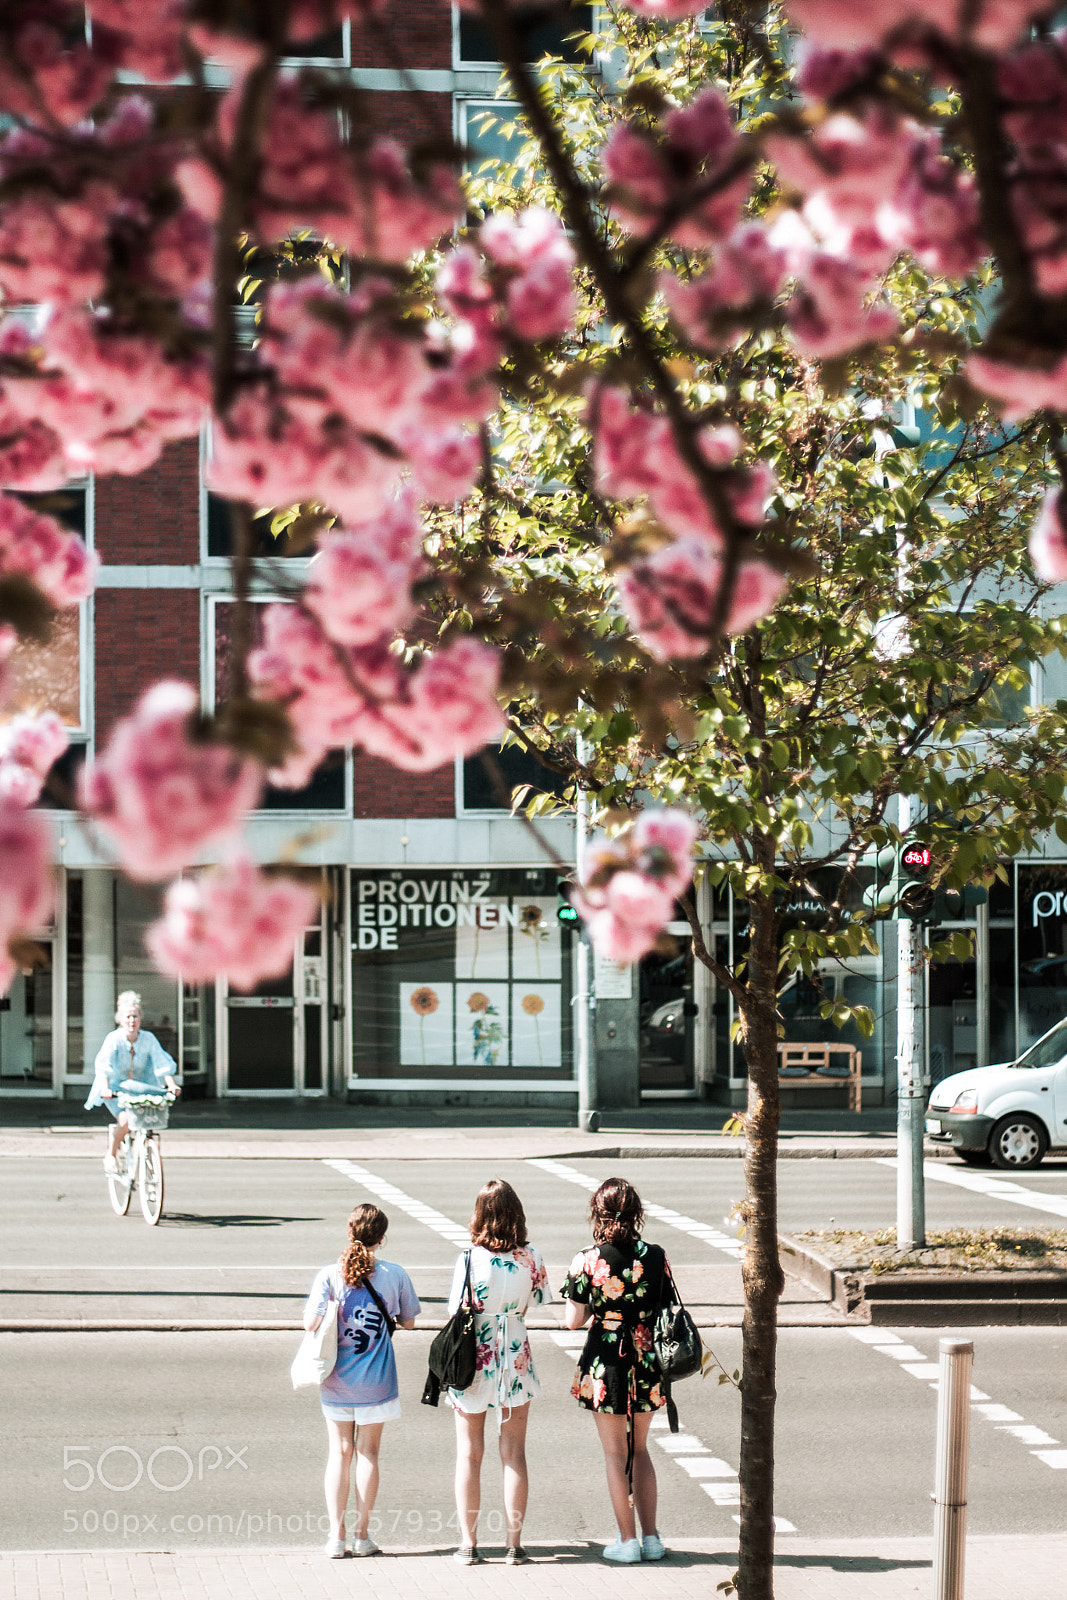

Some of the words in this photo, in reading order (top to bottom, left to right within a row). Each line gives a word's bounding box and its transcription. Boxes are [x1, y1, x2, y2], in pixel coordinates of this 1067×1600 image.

[358, 880, 490, 903] PROVINZ
[358, 904, 519, 927] EDITIONEN
[1033, 891, 1067, 928] pr
[351, 927, 399, 950] .DE
